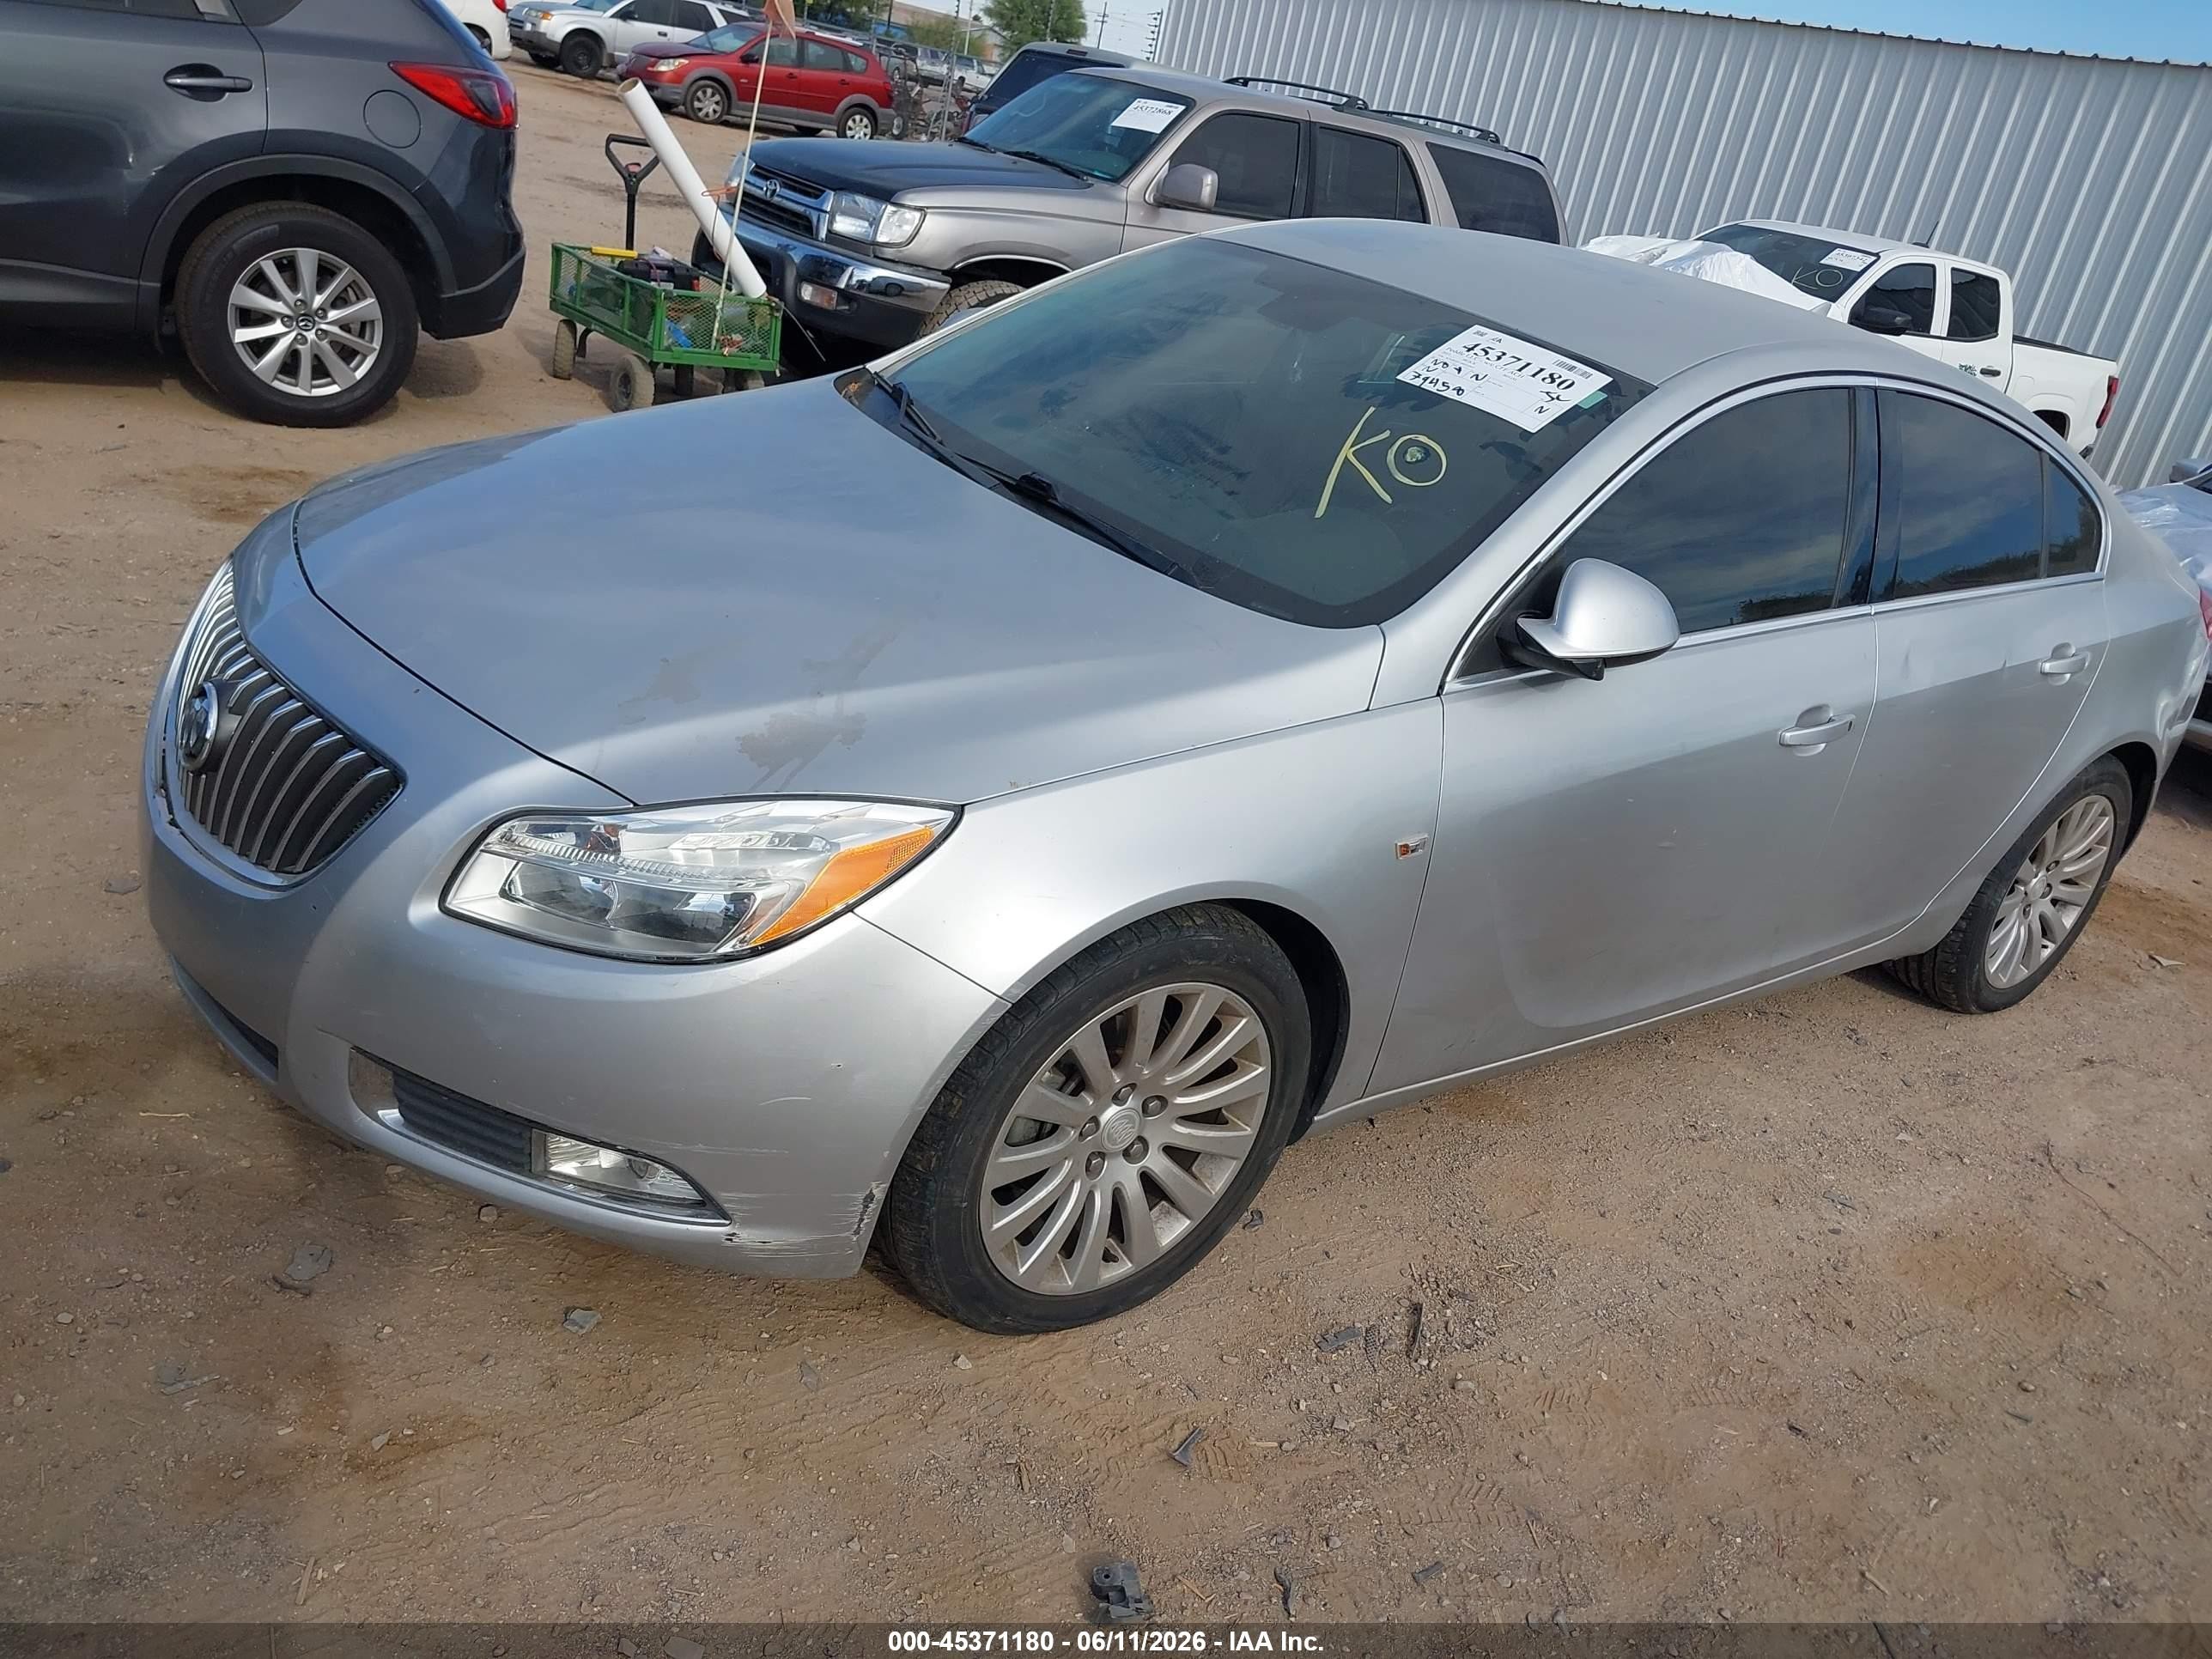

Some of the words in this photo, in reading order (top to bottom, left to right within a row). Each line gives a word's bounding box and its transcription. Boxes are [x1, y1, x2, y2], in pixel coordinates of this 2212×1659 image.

[1792, 265, 1844, 290] KO
[1462, 343, 1577, 391] 45371180
[1314, 406, 1447, 518] KO
